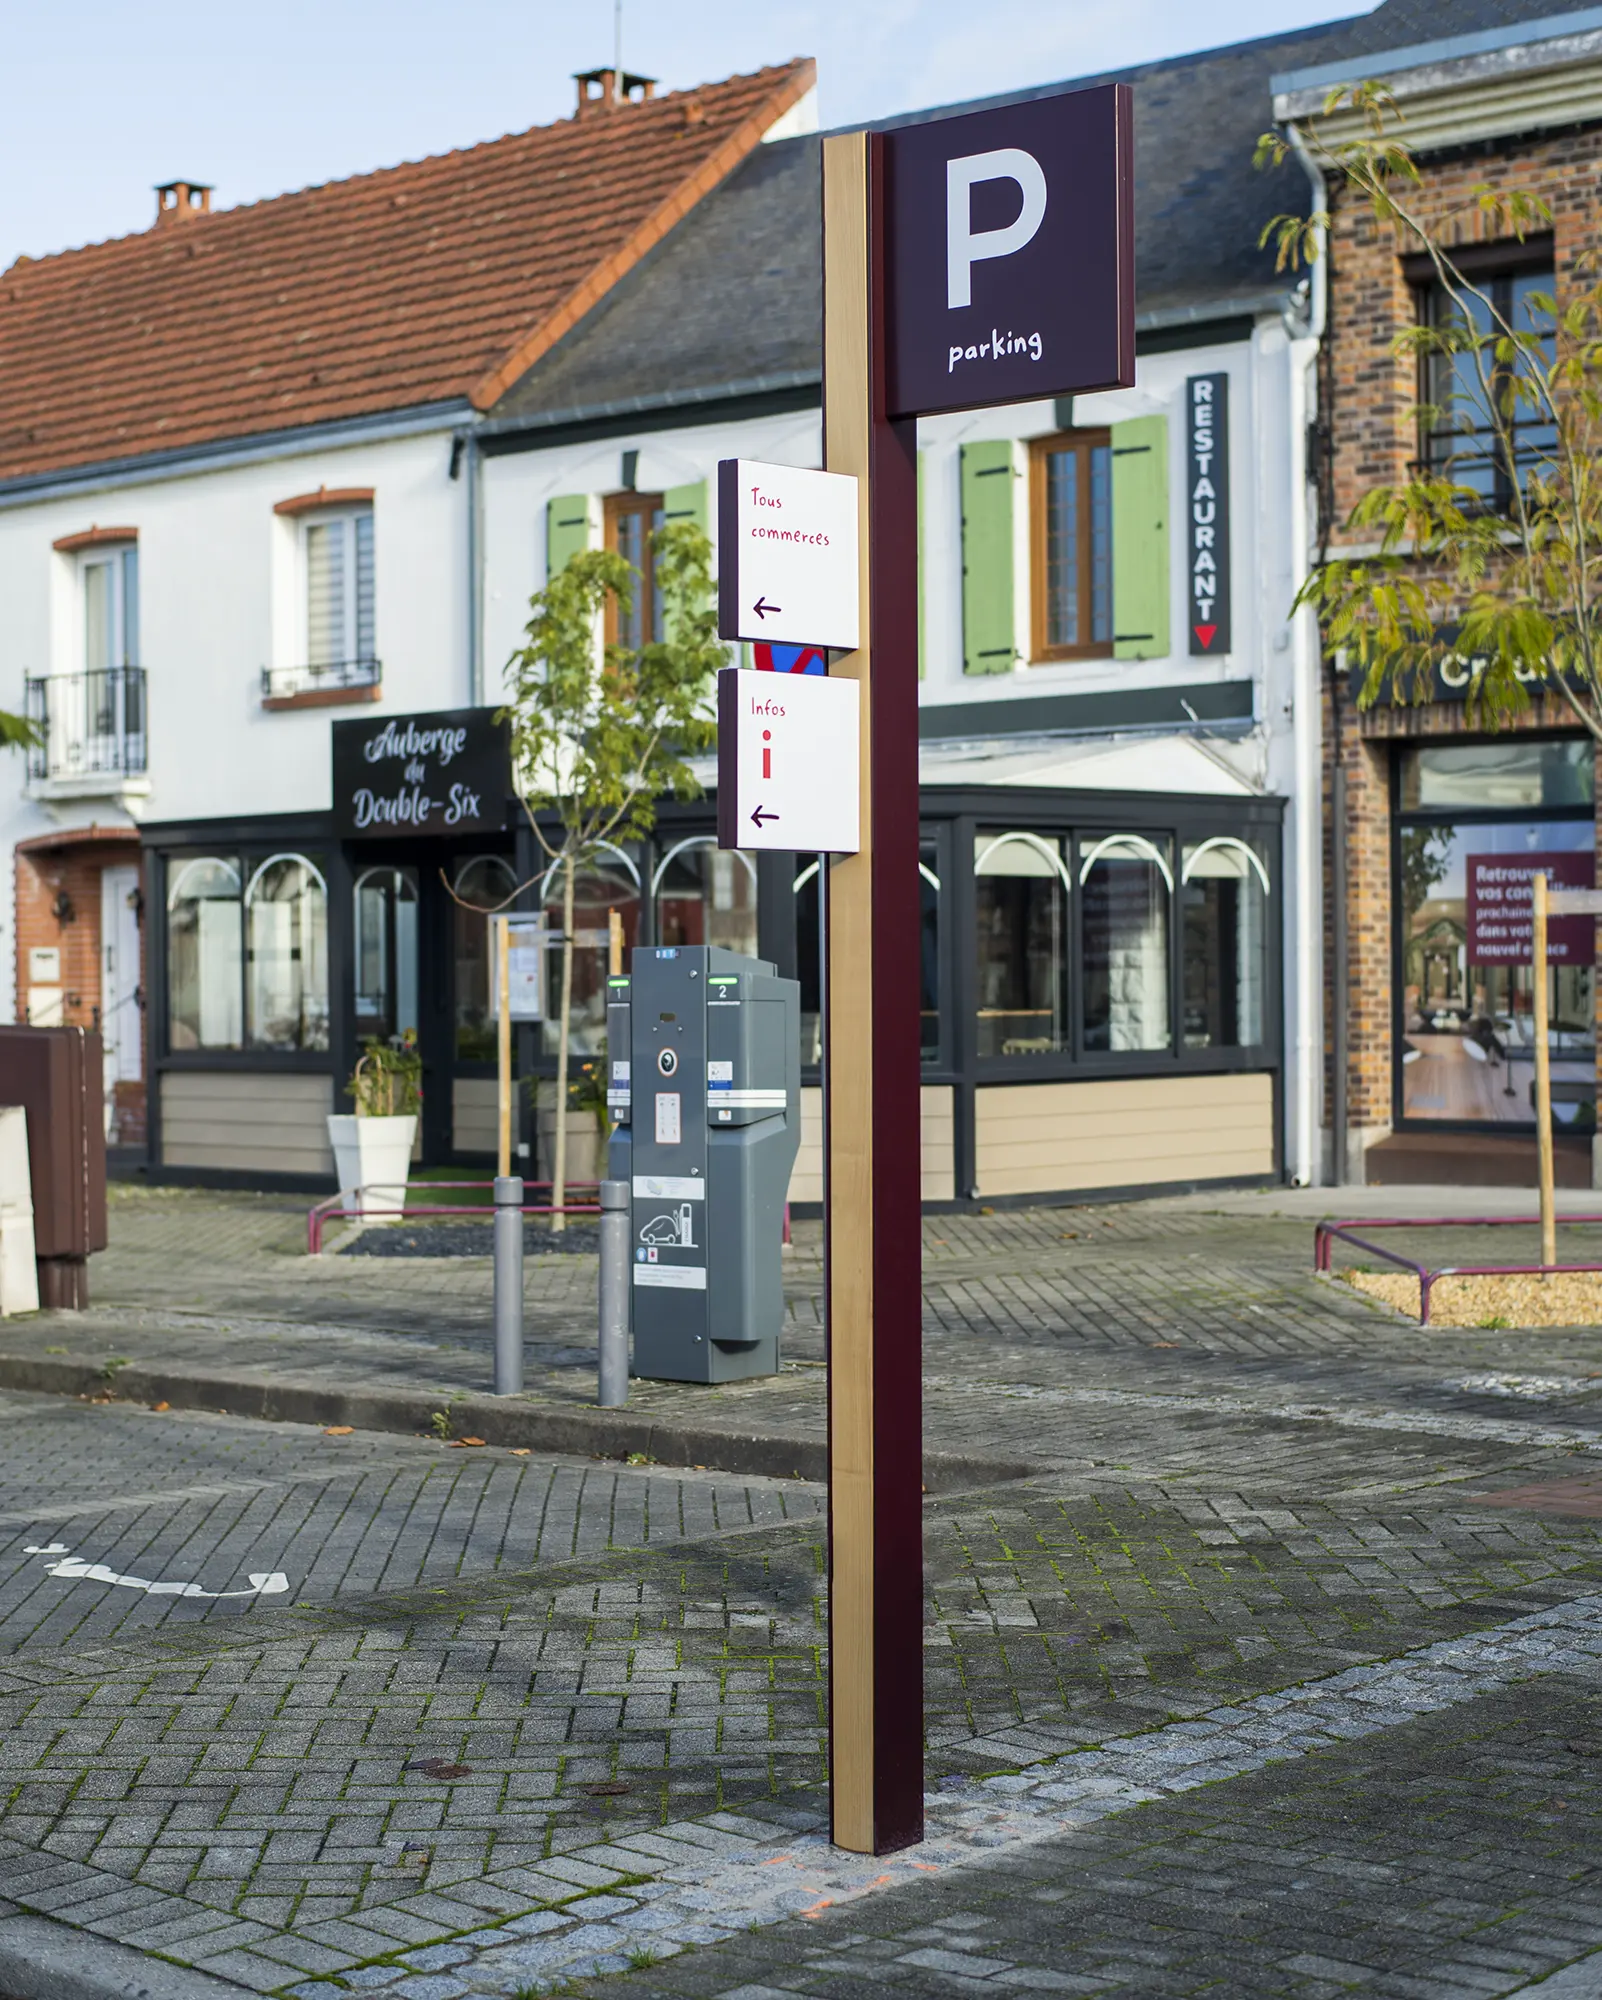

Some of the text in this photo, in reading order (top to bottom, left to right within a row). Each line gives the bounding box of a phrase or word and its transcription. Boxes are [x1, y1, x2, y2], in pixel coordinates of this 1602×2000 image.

[947, 148, 1047, 309] P
[948, 328, 1043, 373] parking
[751, 487, 782, 508] Tous
[1193, 380, 1216, 622] RESTAURANT
[751, 528, 830, 546] commerces
[752, 697, 786, 716] Infos
[364, 720, 467, 766] Auberge
[404, 757, 426, 784] du
[352, 782, 480, 828] Double-Six
[1476, 887, 1502, 900] vos
[1476, 922, 1507, 938] dans
[1476, 941, 1521, 956] nouvel
[718, 985, 727, 998] 2
